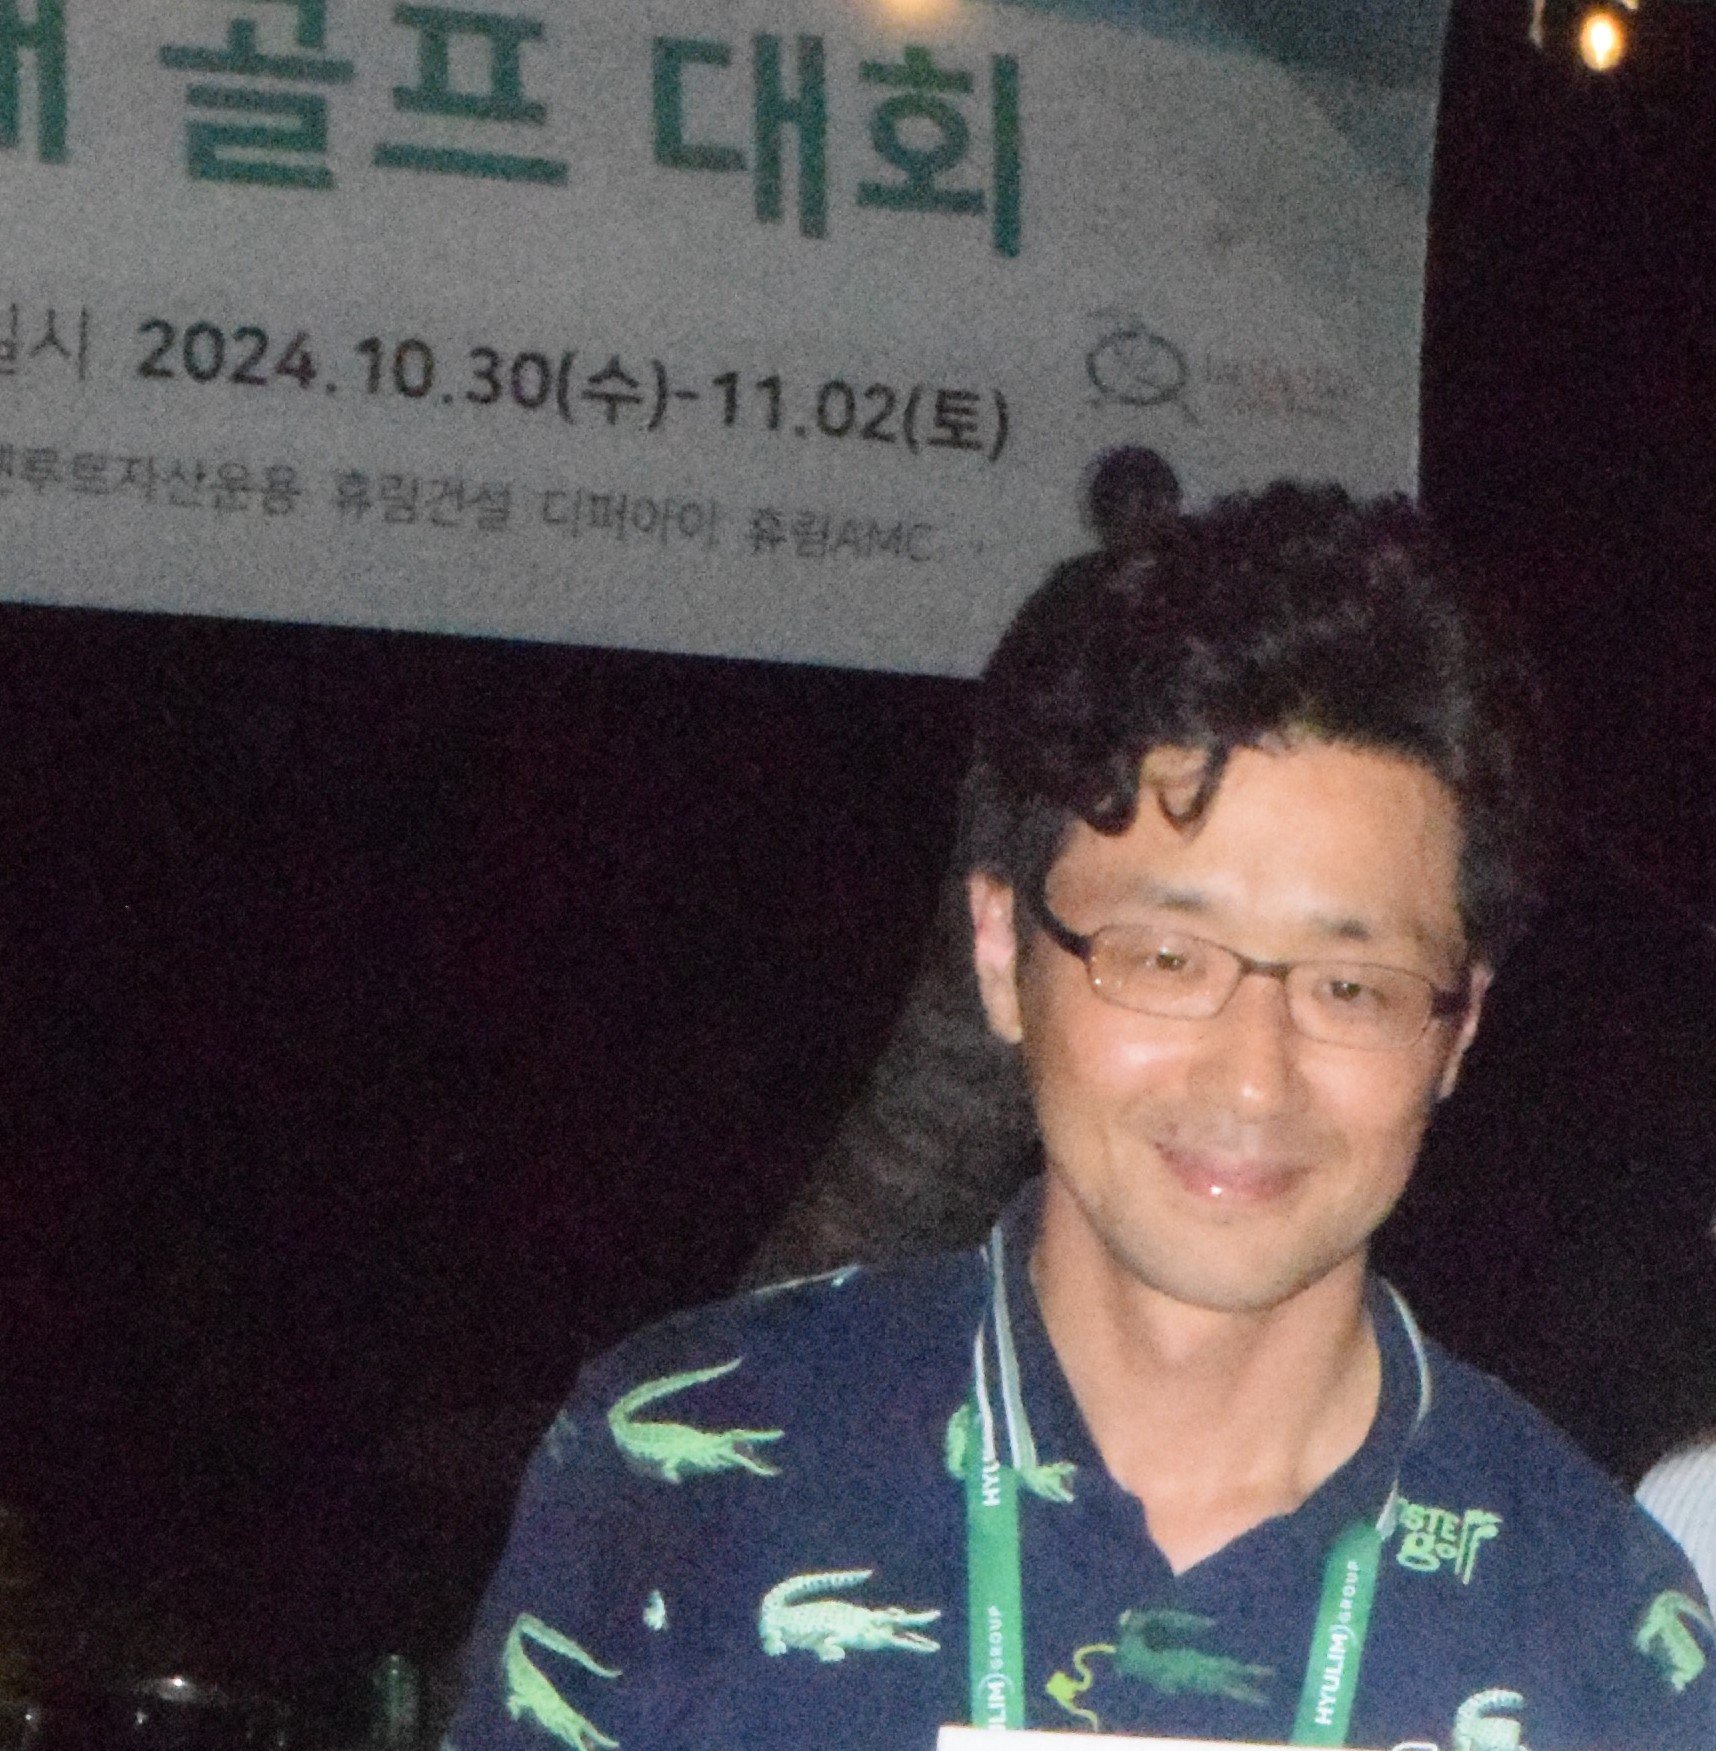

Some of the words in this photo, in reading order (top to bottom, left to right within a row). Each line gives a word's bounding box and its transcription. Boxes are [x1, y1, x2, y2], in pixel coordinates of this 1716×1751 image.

[158, 0, 569, 190] 골프
[650, 33, 1022, 257] 대회
[137, 318, 1009, 462] 2024.10.30(수)-11.02(토)
[749, 507, 935, 562] 휴림AMC
[987, 1605, 1005, 1671] GROUP
[1315, 1633, 1348, 1726] HYULIM
[1338, 1560, 1360, 1624] GROUP
